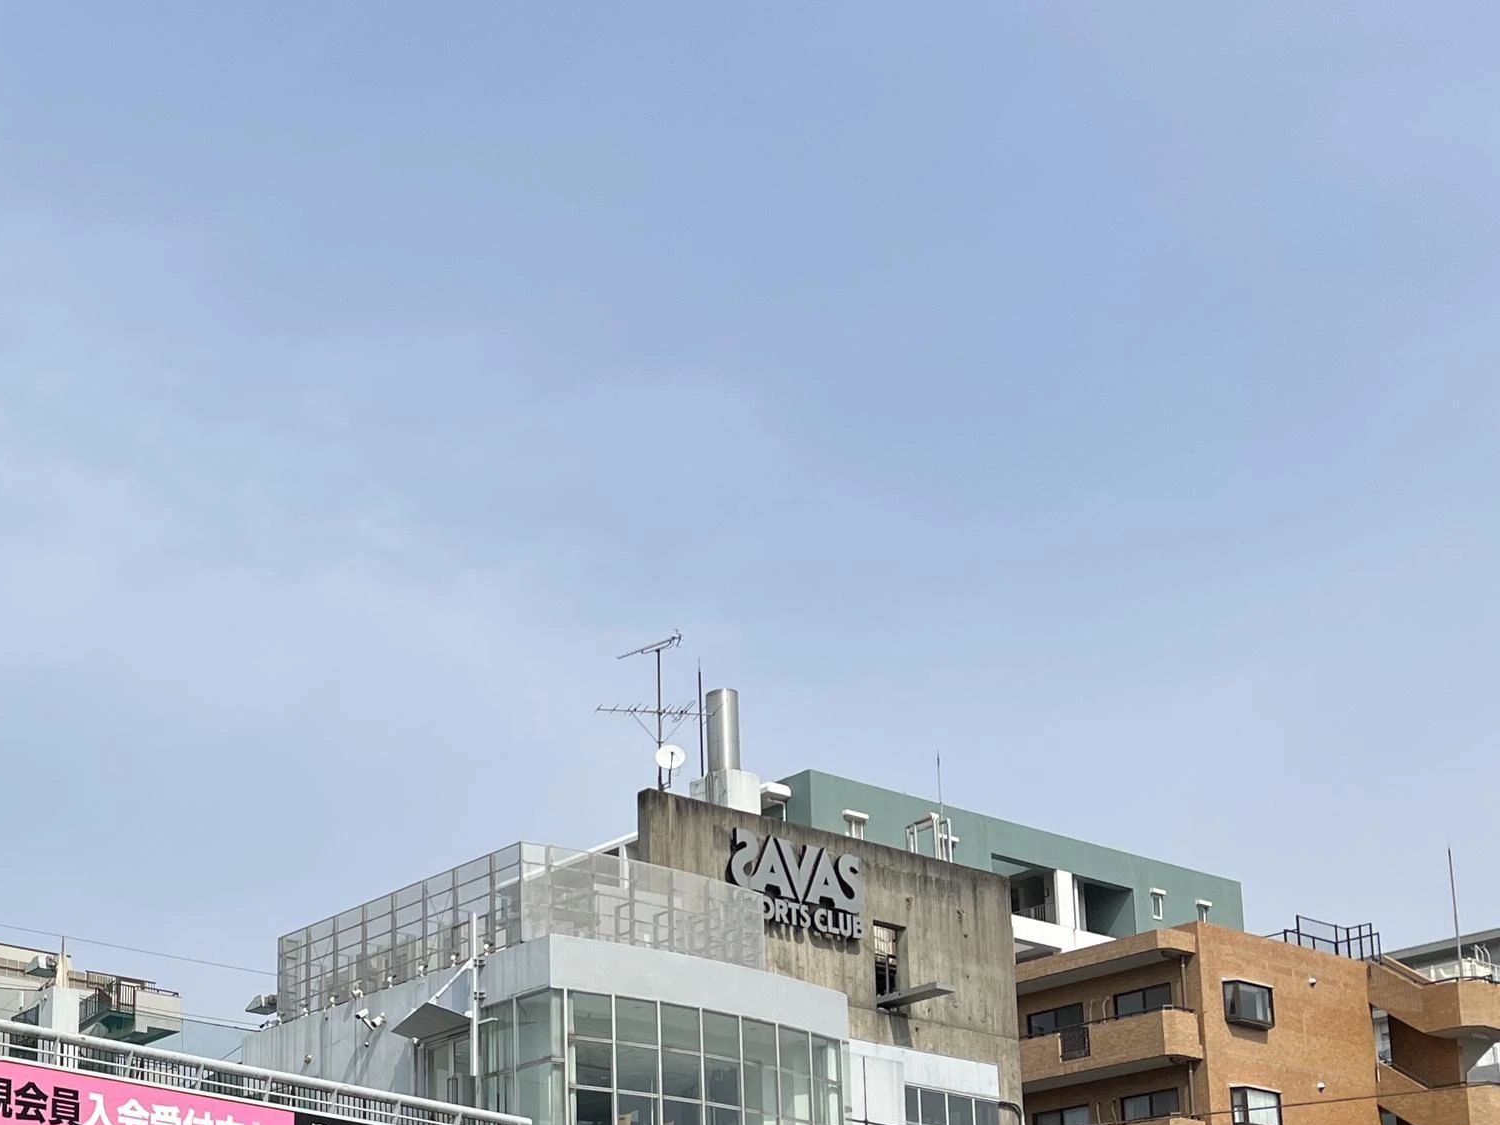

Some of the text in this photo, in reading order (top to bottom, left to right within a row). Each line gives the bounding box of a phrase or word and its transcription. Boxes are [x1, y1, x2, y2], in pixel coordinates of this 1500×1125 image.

[731, 828, 862, 915] SAVAS
[763, 894, 863, 939] ORTS CLUB
